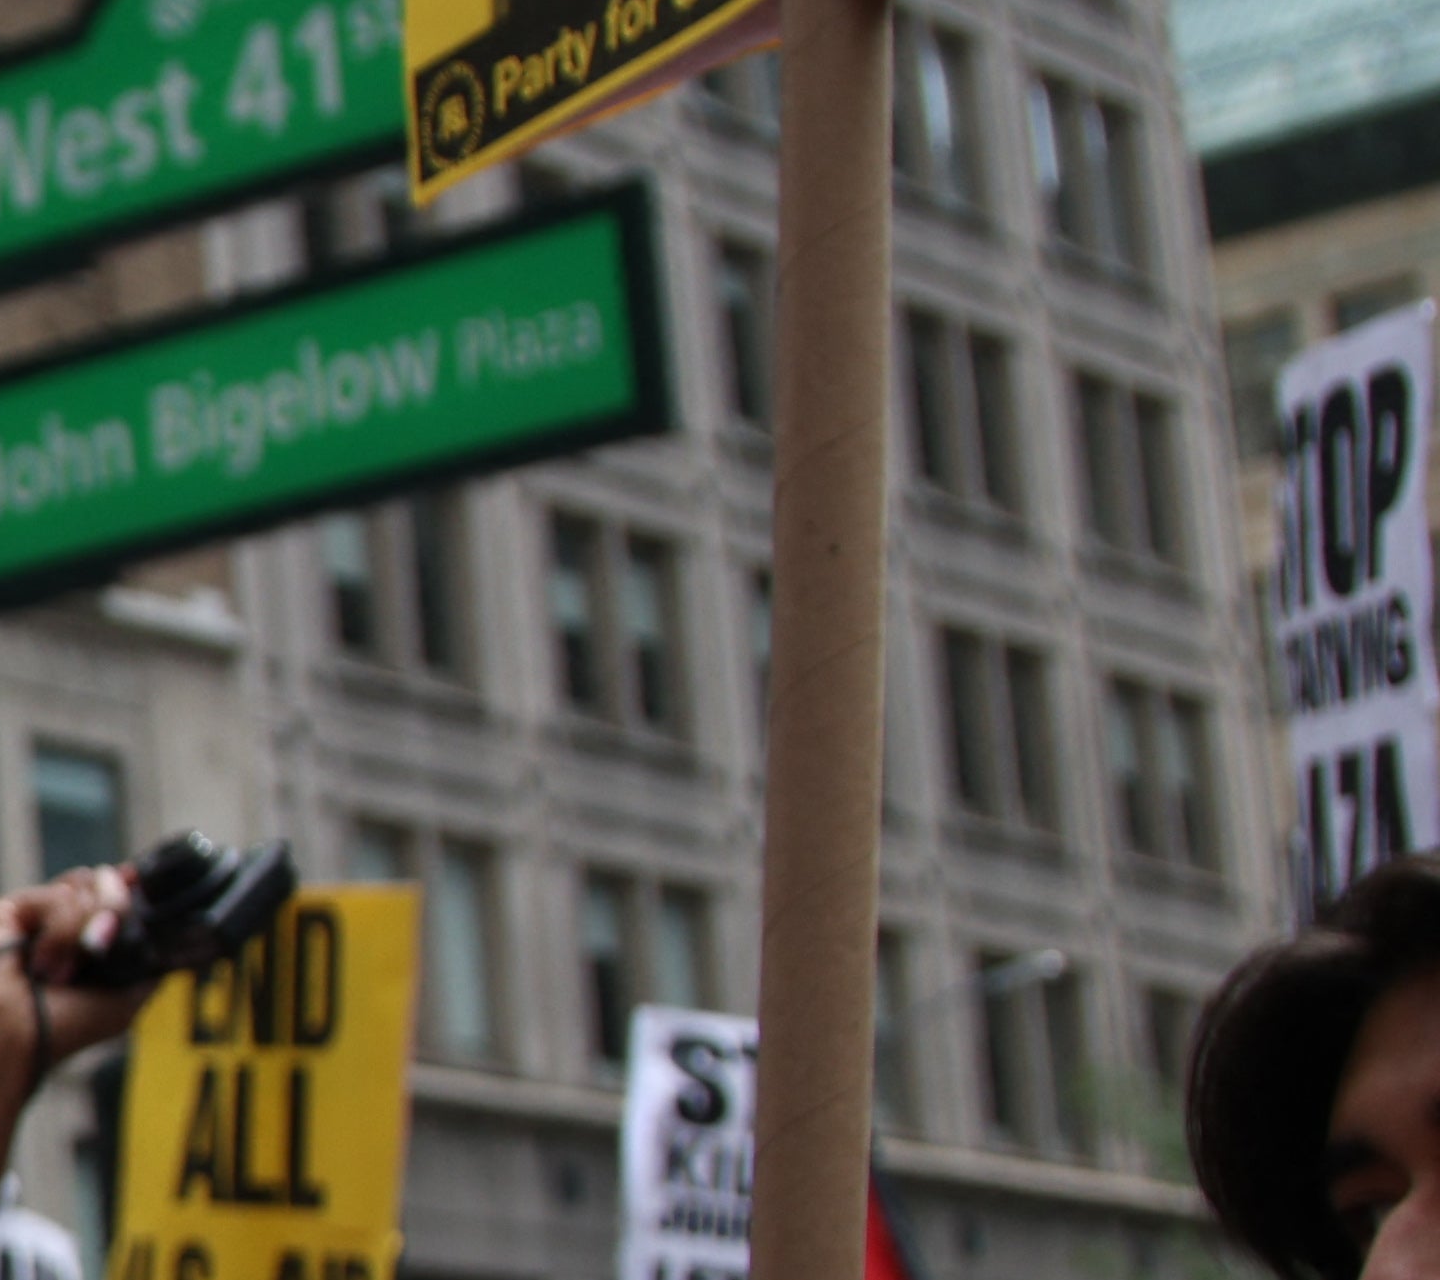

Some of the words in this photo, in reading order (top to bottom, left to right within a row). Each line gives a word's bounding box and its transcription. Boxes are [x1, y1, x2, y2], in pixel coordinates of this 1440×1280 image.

[492, 21, 598, 116] Party
[149, 327, 440, 475] Bigelow
[453, 301, 605, 383] Plaza
[1282, 364, 1412, 609] TOP
[177, 1059, 327, 1210] ALL
